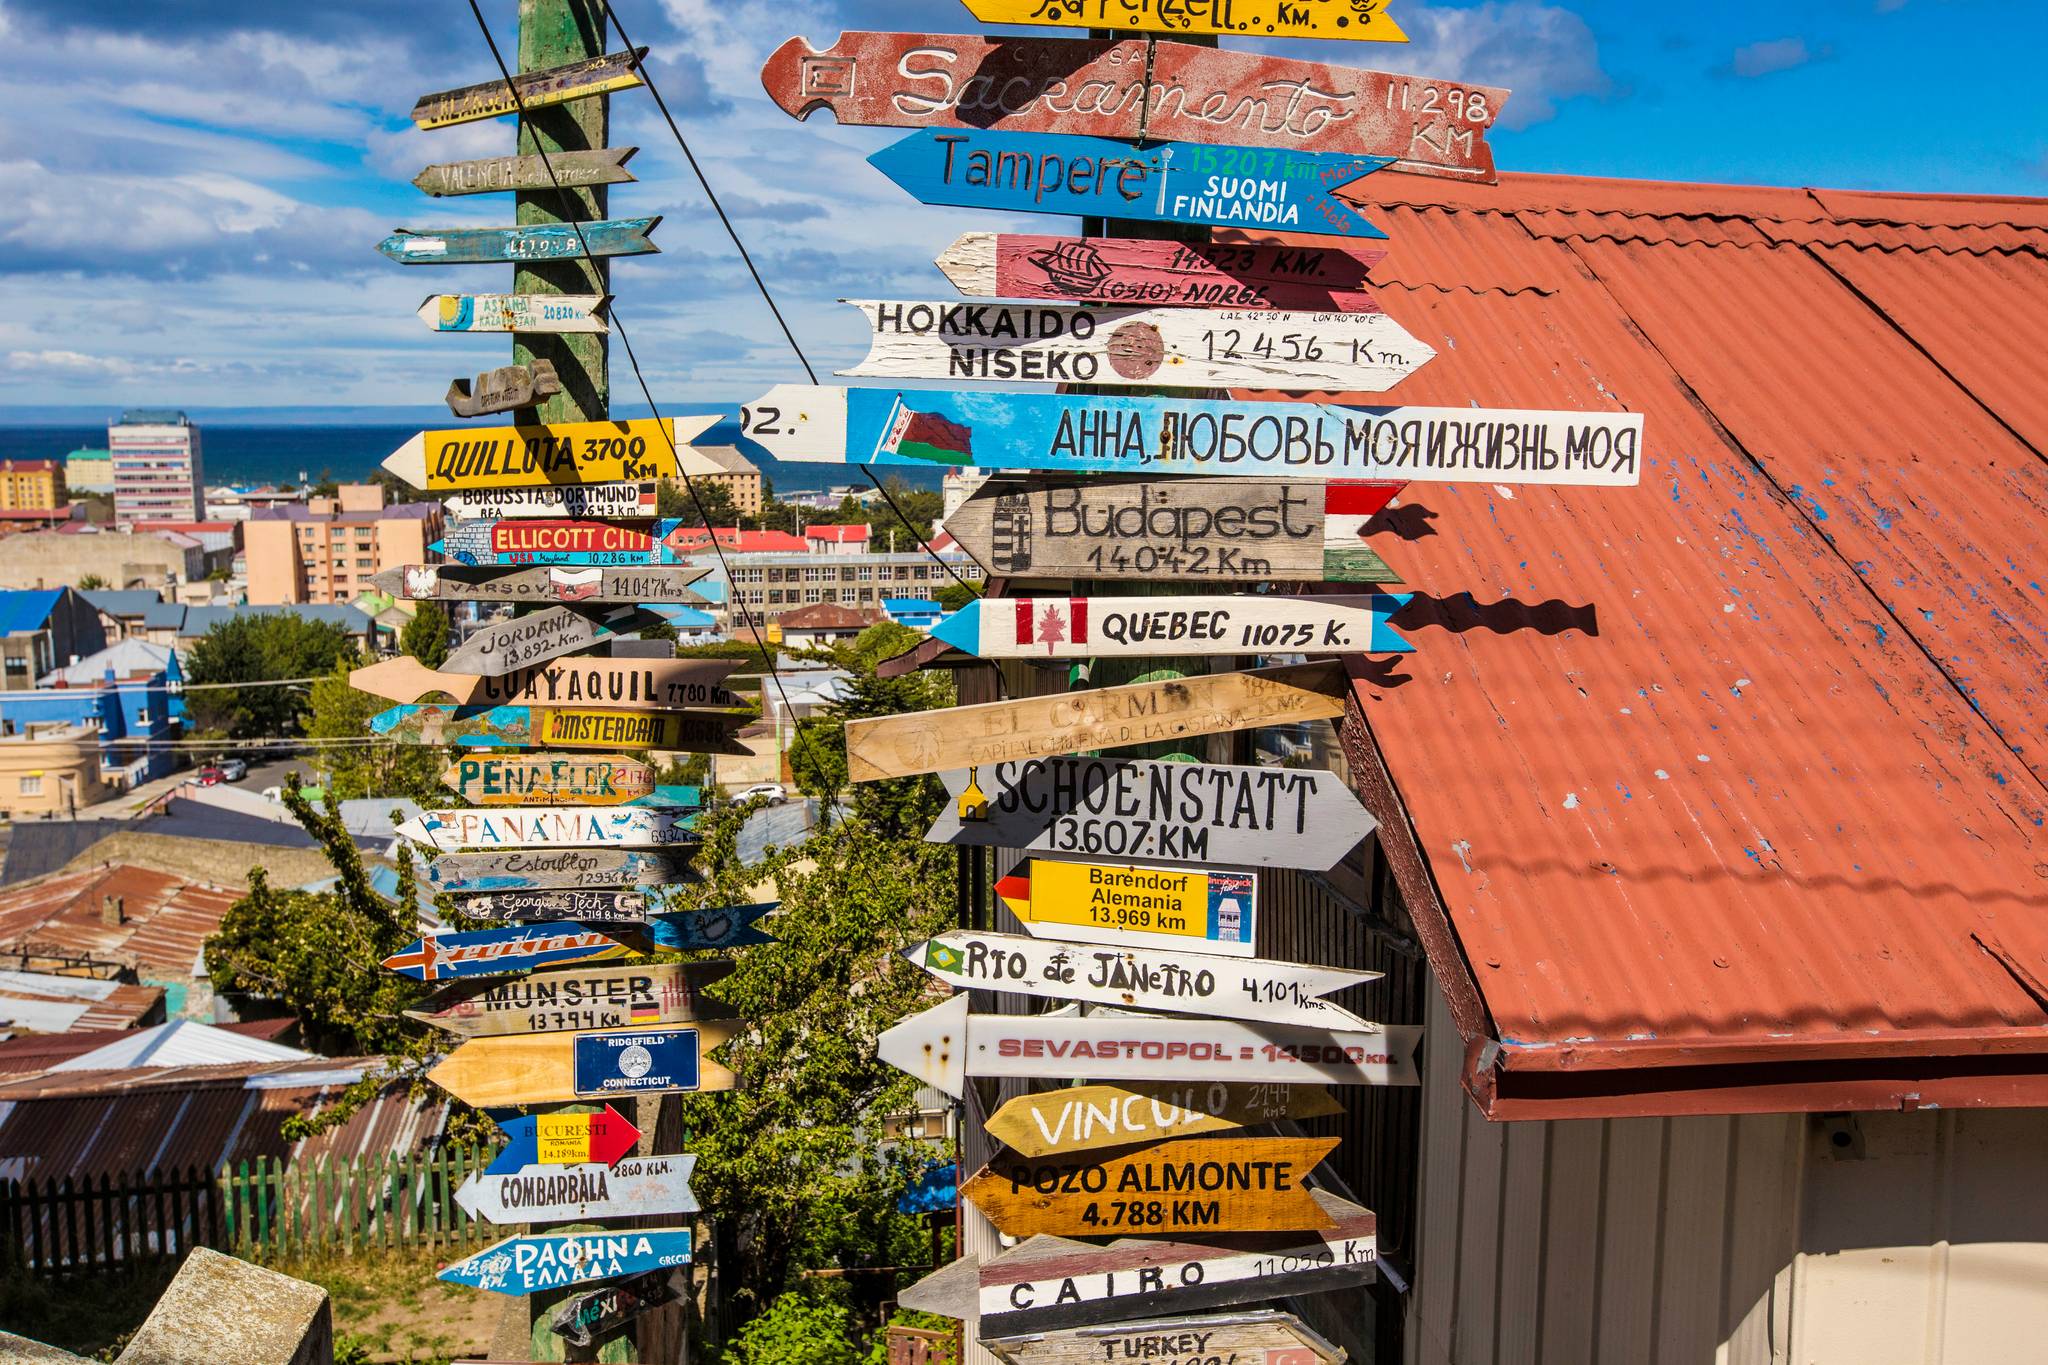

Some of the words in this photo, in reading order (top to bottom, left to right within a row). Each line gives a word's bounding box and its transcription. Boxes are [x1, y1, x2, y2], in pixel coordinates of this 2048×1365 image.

[892, 46, 1354, 138] Sacramento
[1409, 120, 1474, 158] KM
[441, 161, 514, 190] VALENCIA
[934, 135, 1148, 204] Tampere
[1203, 175, 1287, 203] SUOMI
[1173, 195, 1299, 225] FINLANDIA
[483, 296, 529, 312] ASTANA
[543, 305, 573, 321] 20820
[1312, 314, 1331, 322] LON
[878, 303, 1096, 340] HOKKAIDO
[949, 348, 1099, 381] NISEKO
[1565, 425, 1637, 475] МОЯ
[462, 486, 547, 507] BORUSSIA
[553, 485, 637, 504] DORTMUND
[1044, 485, 1317, 549] Budapest
[496, 527, 594, 550] ELLICOTT
[603, 528, 649, 551] CITY
[509, 553, 535, 564] USA
[1217, 547, 1272, 576] Km
[450, 583, 577, 596] VARSOVIA
[1101, 610, 1231, 643] QUEBEC
[1241, 624, 1314, 647] 11075
[1144, 721, 1165, 739] LA
[996, 759, 1318, 834] SCHOENSTATT
[461, 813, 608, 843] PANAMA
[1089, 868, 1189, 892] Barendorf
[1090, 888, 1183, 911] Alemania
[1089, 906, 1151, 926] 13.969
[1156, 910, 1187, 931] km
[608, 1036, 665, 1047] RIDGEFIELD
[998, 1038, 1233, 1062] SEVASTOPOL
[603, 1076, 671, 1088] CONNECTICUT
[1031, 1083, 1228, 1146] VINCULO
[524, 1123, 608, 1139] BUCURESTI
[1010, 1164, 1108, 1195] POZO
[1116, 1161, 1294, 1192] ALMONTE
[1082, 1200, 1164, 1227] 4.788
[1172, 1200, 1220, 1225] KM
[1009, 1261, 1206, 1310] CAIRO
[1101, 1333, 1213, 1361] TURKEY
